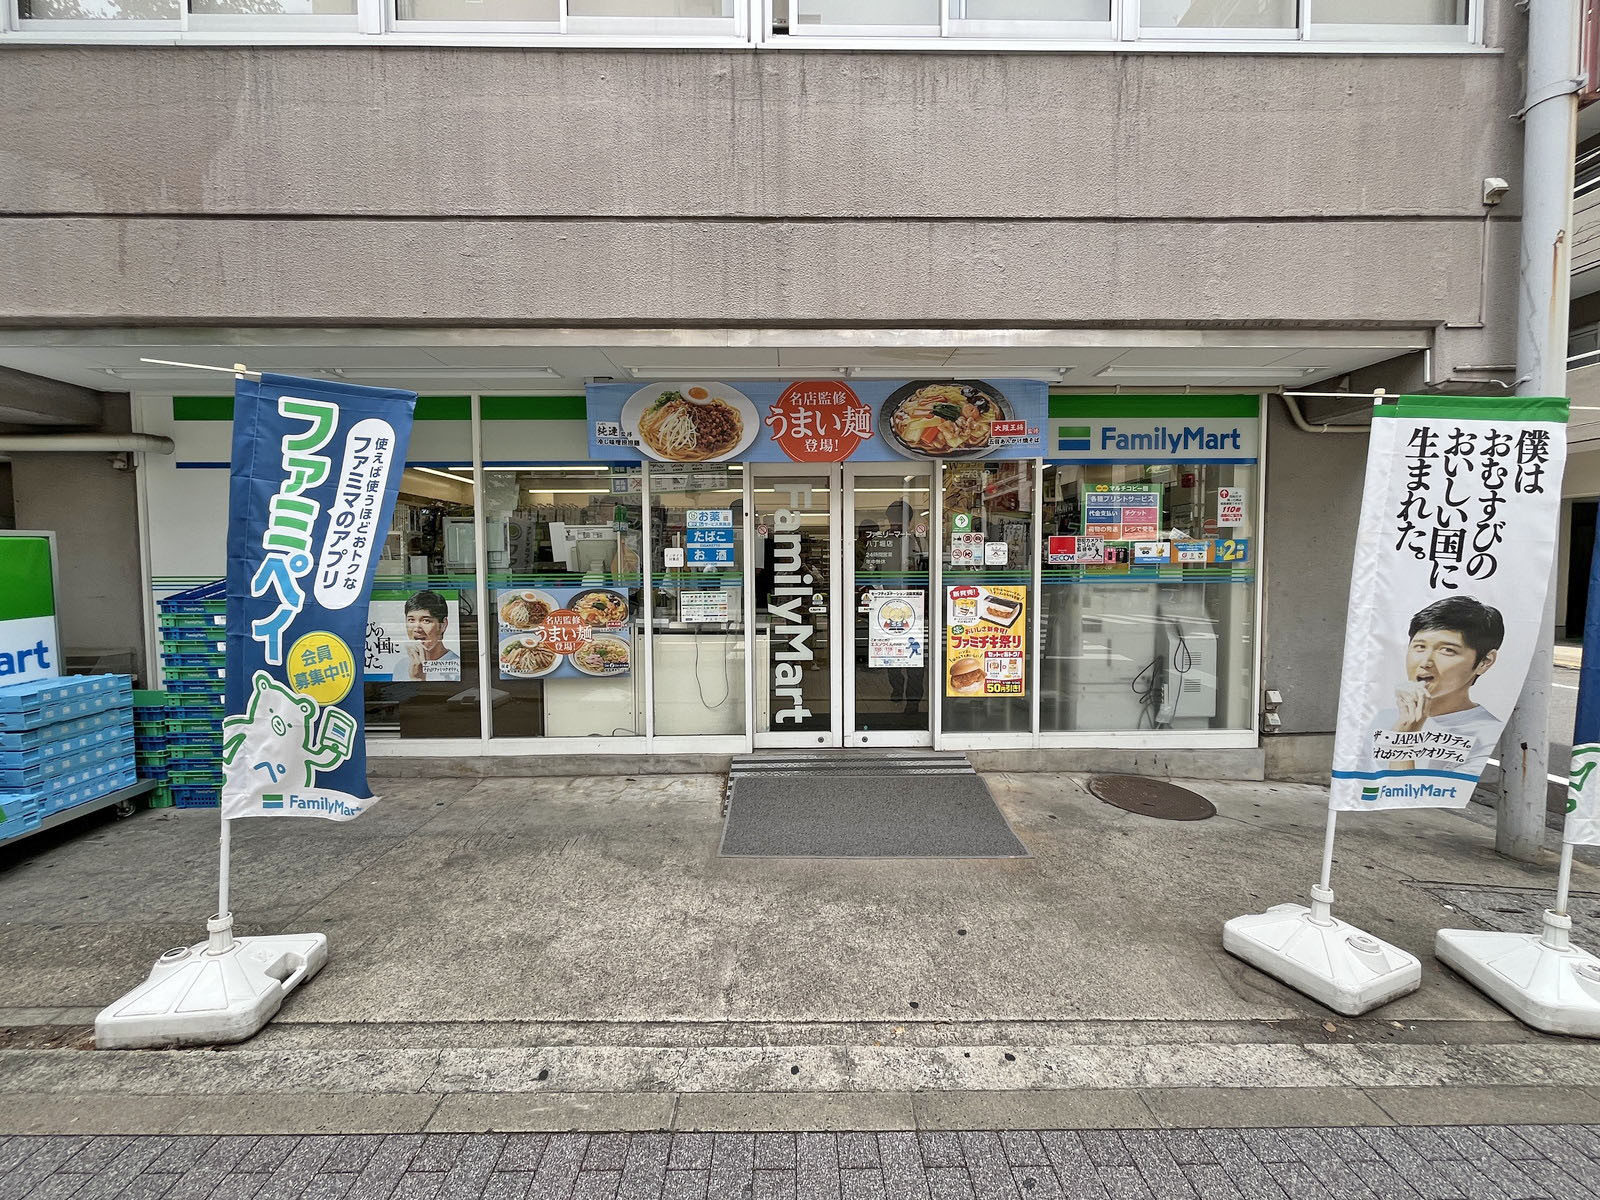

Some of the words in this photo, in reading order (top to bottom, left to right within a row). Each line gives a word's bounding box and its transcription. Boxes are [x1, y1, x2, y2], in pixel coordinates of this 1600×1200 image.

[790, 391, 847, 406] 名店監修
[766, 405, 874, 440] うまい麺
[1101, 426, 1241, 454] FamilyMart
[1514, 429, 1551, 494] 僕は
[1395, 426, 1441, 560] 生まれた。
[1466, 428, 1514, 581] おむすびの
[323, 436, 372, 589] ファミマのアプリ
[343, 437, 389, 590] 使えば使うほどおトクな
[699, 511, 721, 522] お薬
[1429, 427, 1478, 590] おいしい国に
[252, 398, 338, 664] ファミペイ
[693, 530, 727, 542] たばこ
[865, 530, 912, 539] ファミリーマート
[694, 549, 728, 561] お酒
[768, 483, 814, 724] FamilyMart
[534, 624, 593, 643] うまい麺
[951, 635, 1022, 649] ファミチキ祭り
[301, 644, 333, 668] 会員
[1380, 783, 1457, 799] FamilyMart
